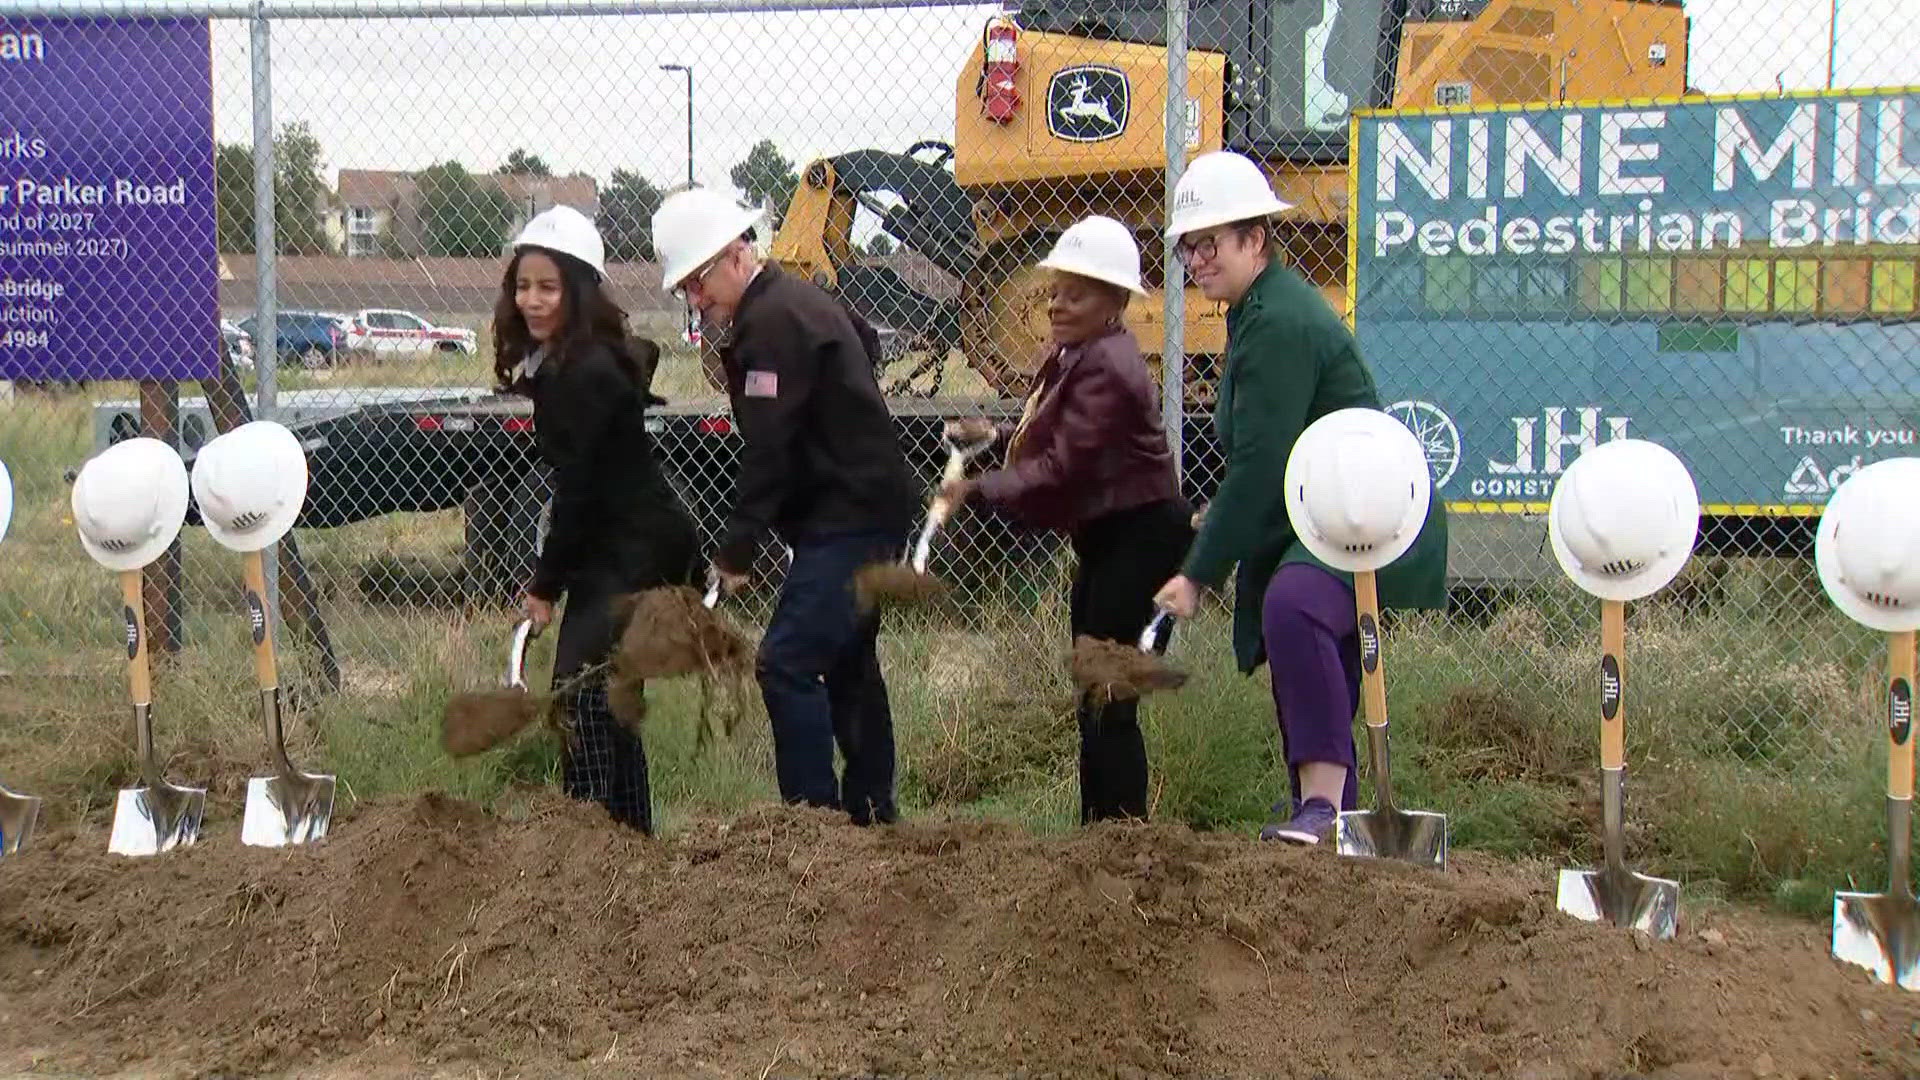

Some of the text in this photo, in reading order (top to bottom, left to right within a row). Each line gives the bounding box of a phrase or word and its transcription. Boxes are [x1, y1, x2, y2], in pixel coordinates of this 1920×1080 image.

[1376, 112, 1666, 201] NINE
[18, 178, 106, 205] Parker
[115, 177, 185, 205] Road
[25, 212, 43, 230] of
[49, 213, 94, 230] 2027
[1375, 198, 1742, 256] Pedestrian
[76, 238, 128, 260] 2027)
[1780, 424, 1915, 448] Thank you
[1471, 478, 1554, 496] CONST
[1604, 671, 1618, 703] JHL
